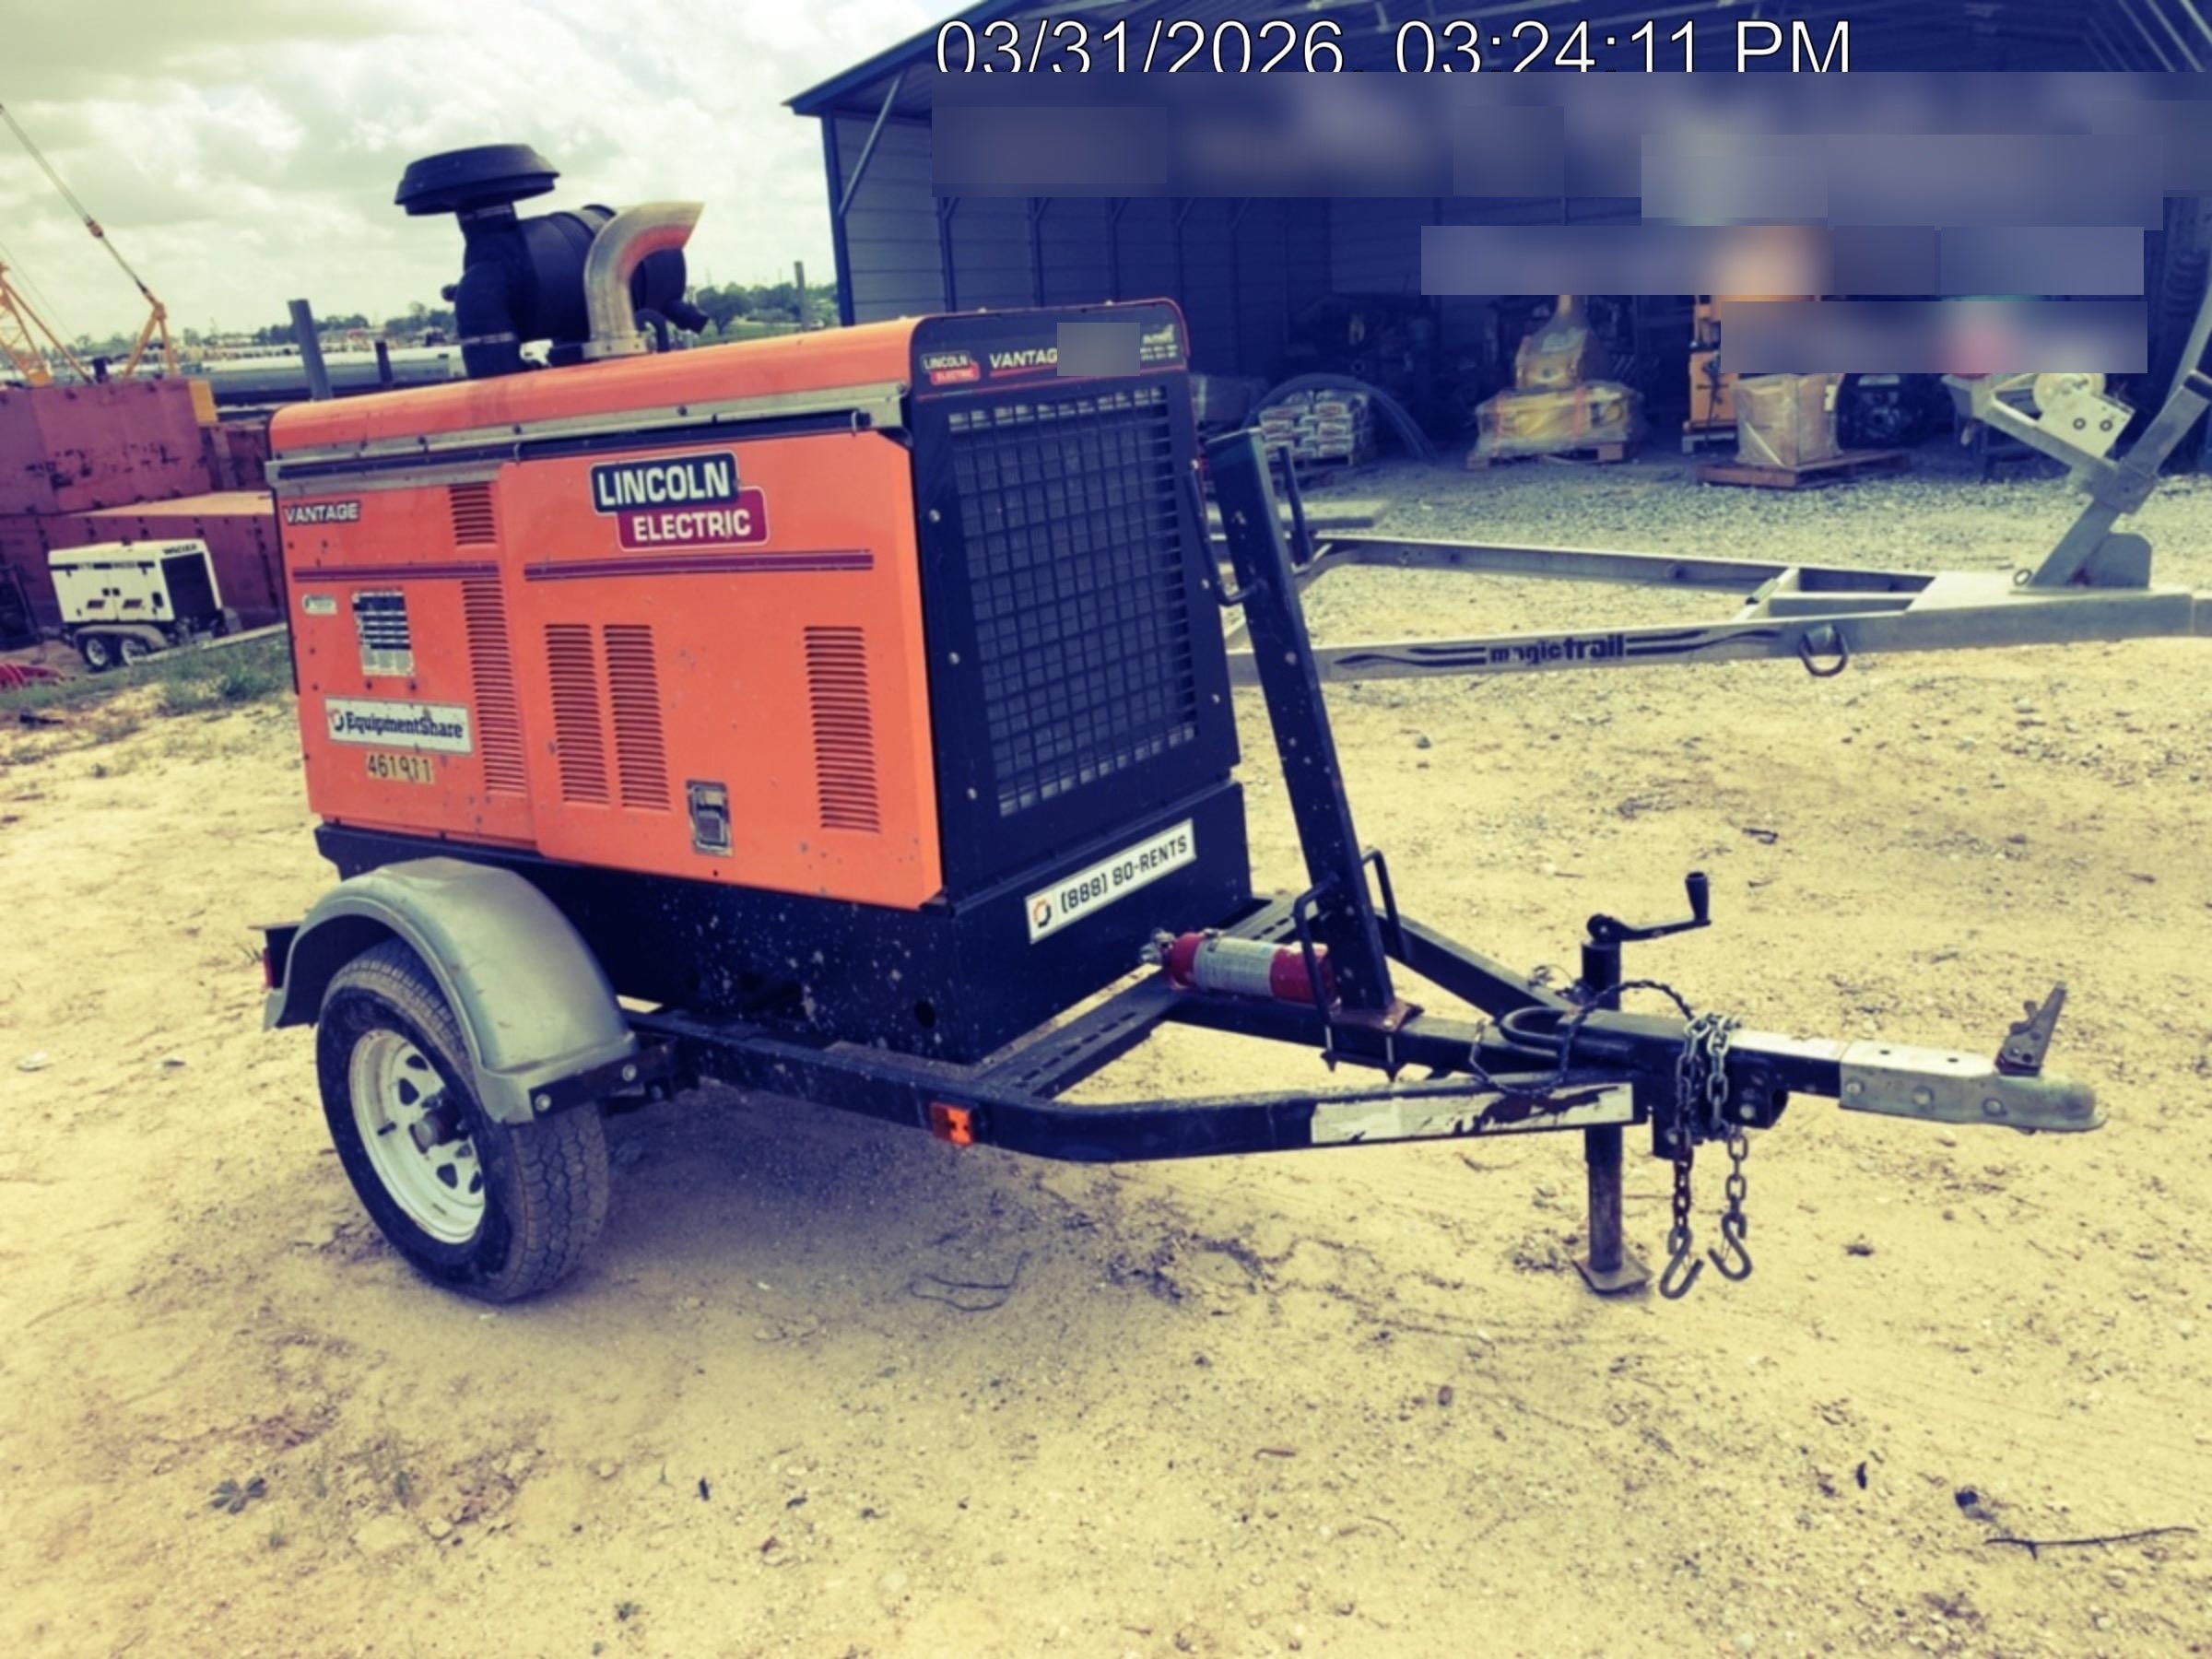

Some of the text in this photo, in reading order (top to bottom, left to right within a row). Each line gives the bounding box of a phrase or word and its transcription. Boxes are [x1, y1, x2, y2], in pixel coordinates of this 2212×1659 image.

[923, 354, 968, 371] LINCOLN
[989, 347, 1058, 370] VANTAG
[598, 461, 731, 506] LINCOLN
[284, 501, 359, 524] VANTAGE
[632, 509, 751, 542] ELECTRIC
[345, 711, 464, 739] EquipmentShare
[368, 753, 431, 782] 461911
[1060, 834, 1188, 913] (888) 80-RENTS
